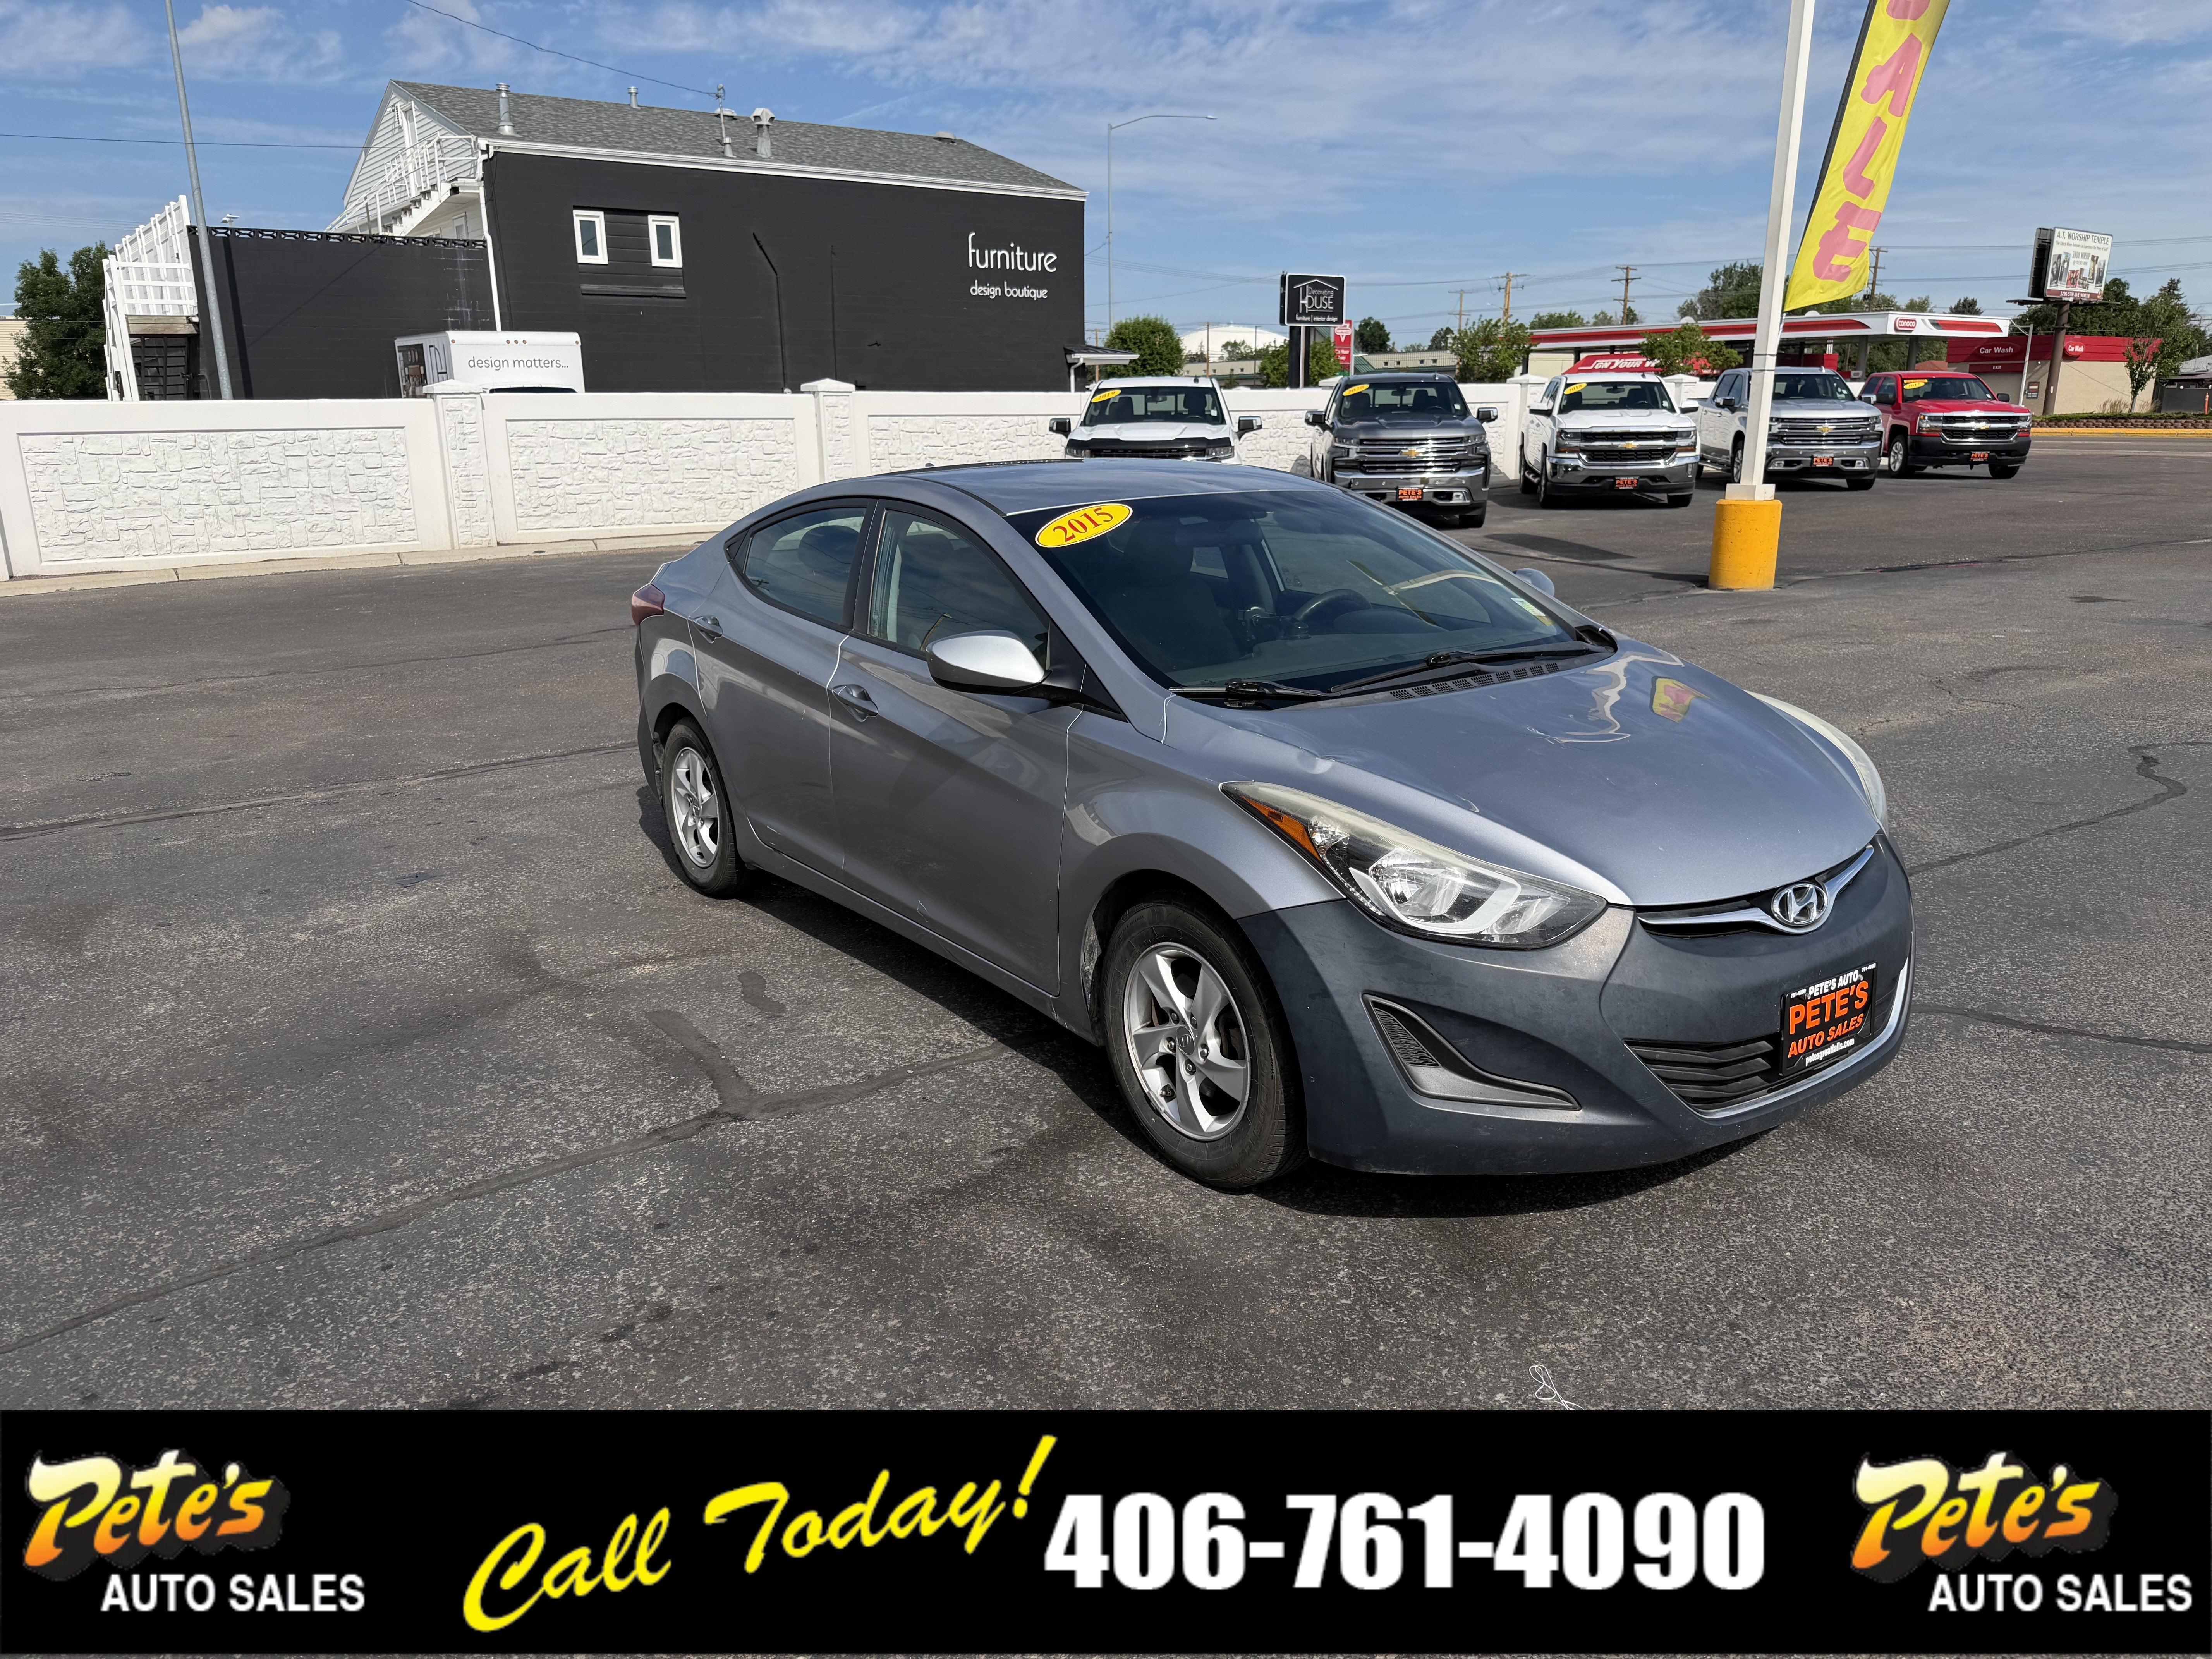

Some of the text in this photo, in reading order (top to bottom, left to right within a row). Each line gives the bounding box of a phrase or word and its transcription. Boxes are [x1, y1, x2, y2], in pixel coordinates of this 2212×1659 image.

[1813, 0, 1930, 282] ALE
[968, 232, 1057, 272] furniture
[2068, 232, 2090, 242] WORSHIP
[2091, 235, 2109, 245] TEMPLE
[970, 279, 1048, 300] design boutique
[468, 356, 569, 371] design matters...
[1053, 507, 1113, 542] 2015
[1809, 978, 1836, 996] PETE'S
[1837, 970, 1858, 988] AUTO
[1789, 981, 1869, 1035] PETE'S
[1788, 1013, 1864, 1058] AUTO SALES
[1805, 1038, 1855, 1066] petesgreatfalls.com
